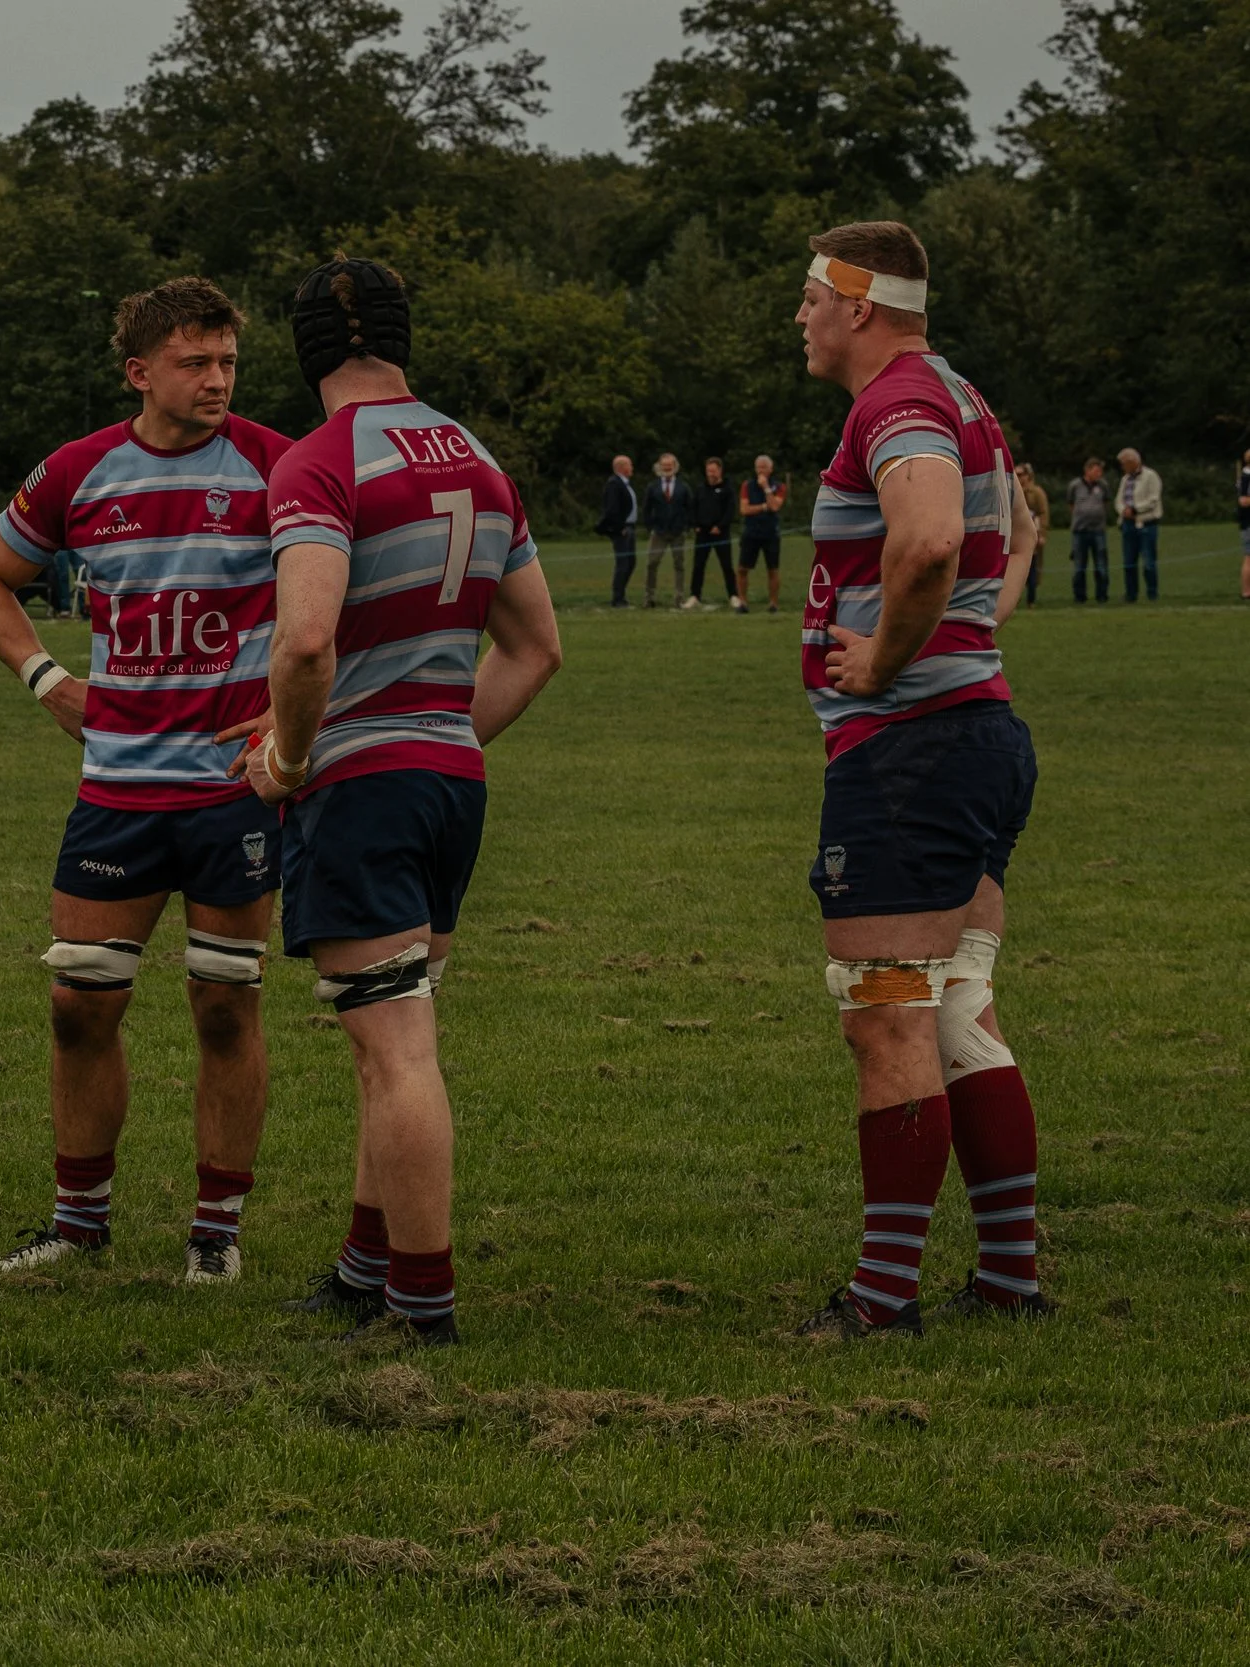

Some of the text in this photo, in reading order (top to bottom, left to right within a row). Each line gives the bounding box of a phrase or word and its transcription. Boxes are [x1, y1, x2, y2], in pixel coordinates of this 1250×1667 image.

[389, 428, 470, 463] Life
[456, 461, 478, 471] LIVING
[271, 499, 303, 519] UMA
[93, 522, 143, 537] AKUMA
[430, 488, 474, 605] 7
[110, 590, 230, 656] Life
[110, 660, 231, 675] KITCHENS FOR LIVING
[417, 719, 460, 728] AKUMA
[79, 859, 126, 877] AKUMA
